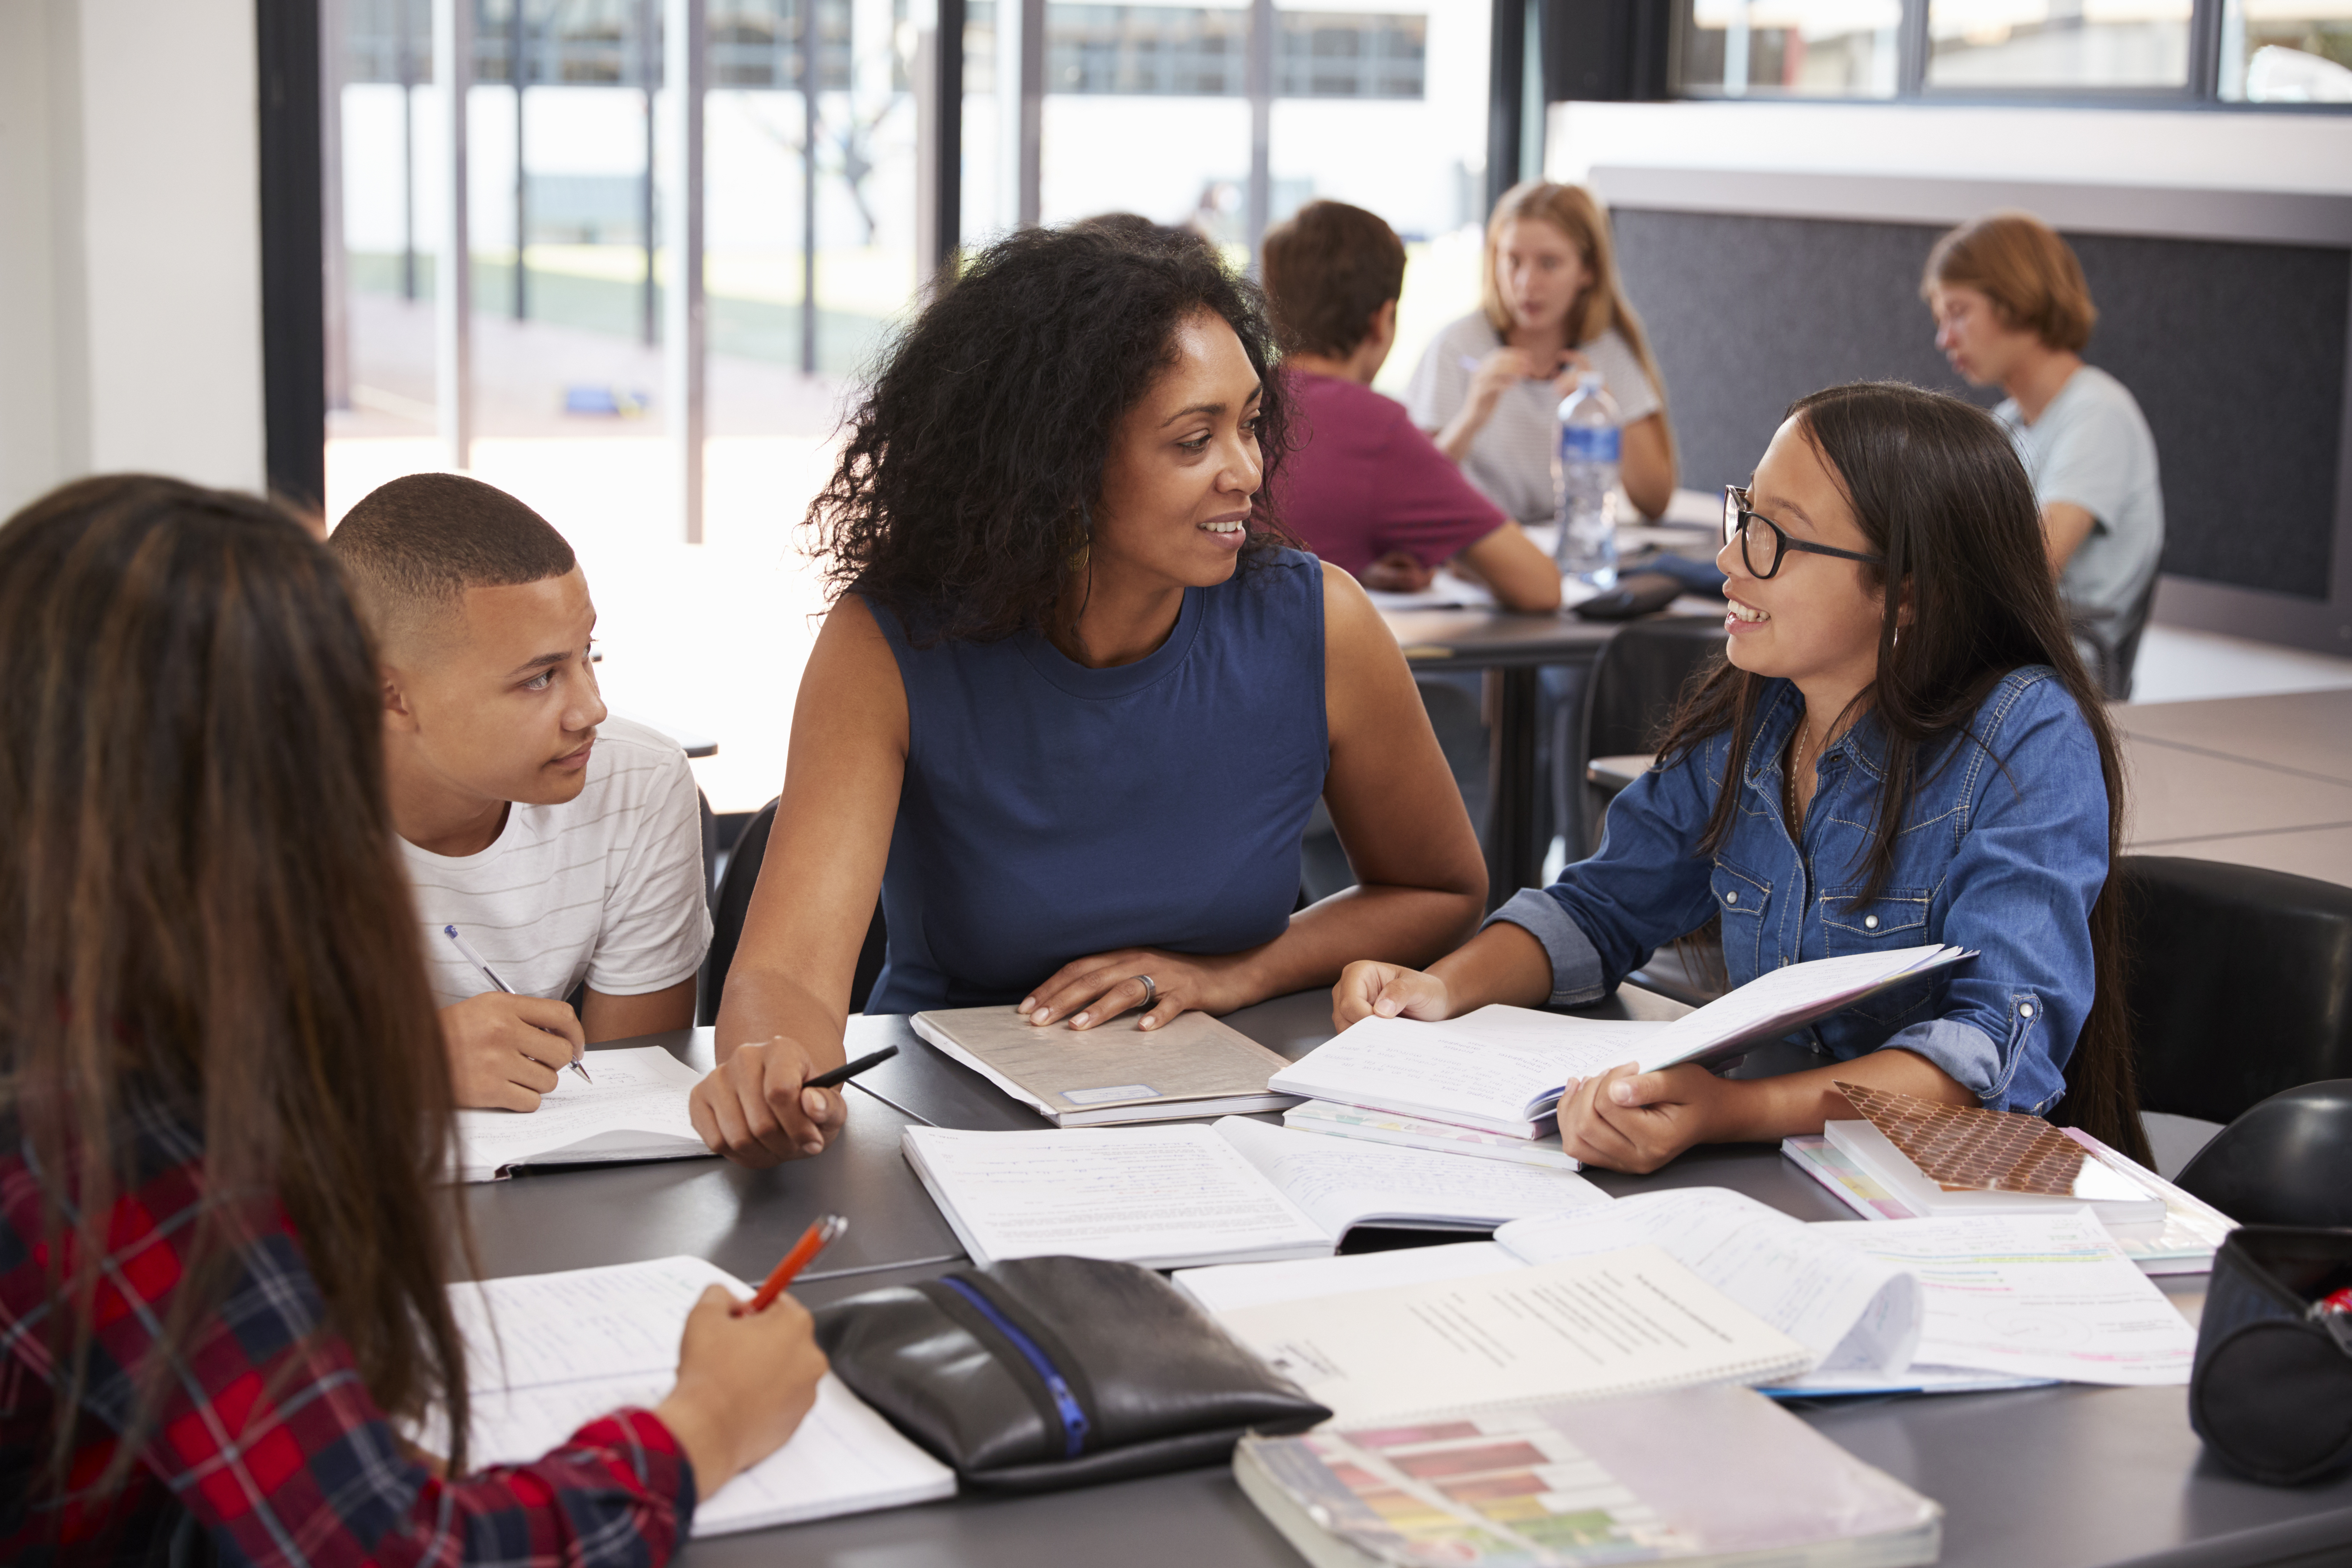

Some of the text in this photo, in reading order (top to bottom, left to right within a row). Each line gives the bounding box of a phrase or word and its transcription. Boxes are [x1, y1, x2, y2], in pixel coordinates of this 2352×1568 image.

[1385, 1048, 1422, 1058] molecule
[1437, 1039, 1545, 1070] carbohydrates carbohydrase
[1403, 1057, 1436, 1066] products
[1430, 1056, 1462, 1066] another
[1443, 1045, 1541, 1074] protein protease
[1531, 1058, 1552, 1068] lipids
[1381, 1064, 1424, 1075] (substrate)
[1428, 1077, 1461, 1087] molecule
[1432, 1073, 1466, 1083] molecule
[1517, 1073, 1548, 1087] substrate
[1472, 1081, 1503, 1092] reacting
[1501, 1078, 1534, 1092] reaction
[1467, 1086, 1494, 1095] enzyme
[1466, 1091, 1494, 1101] enzymes
